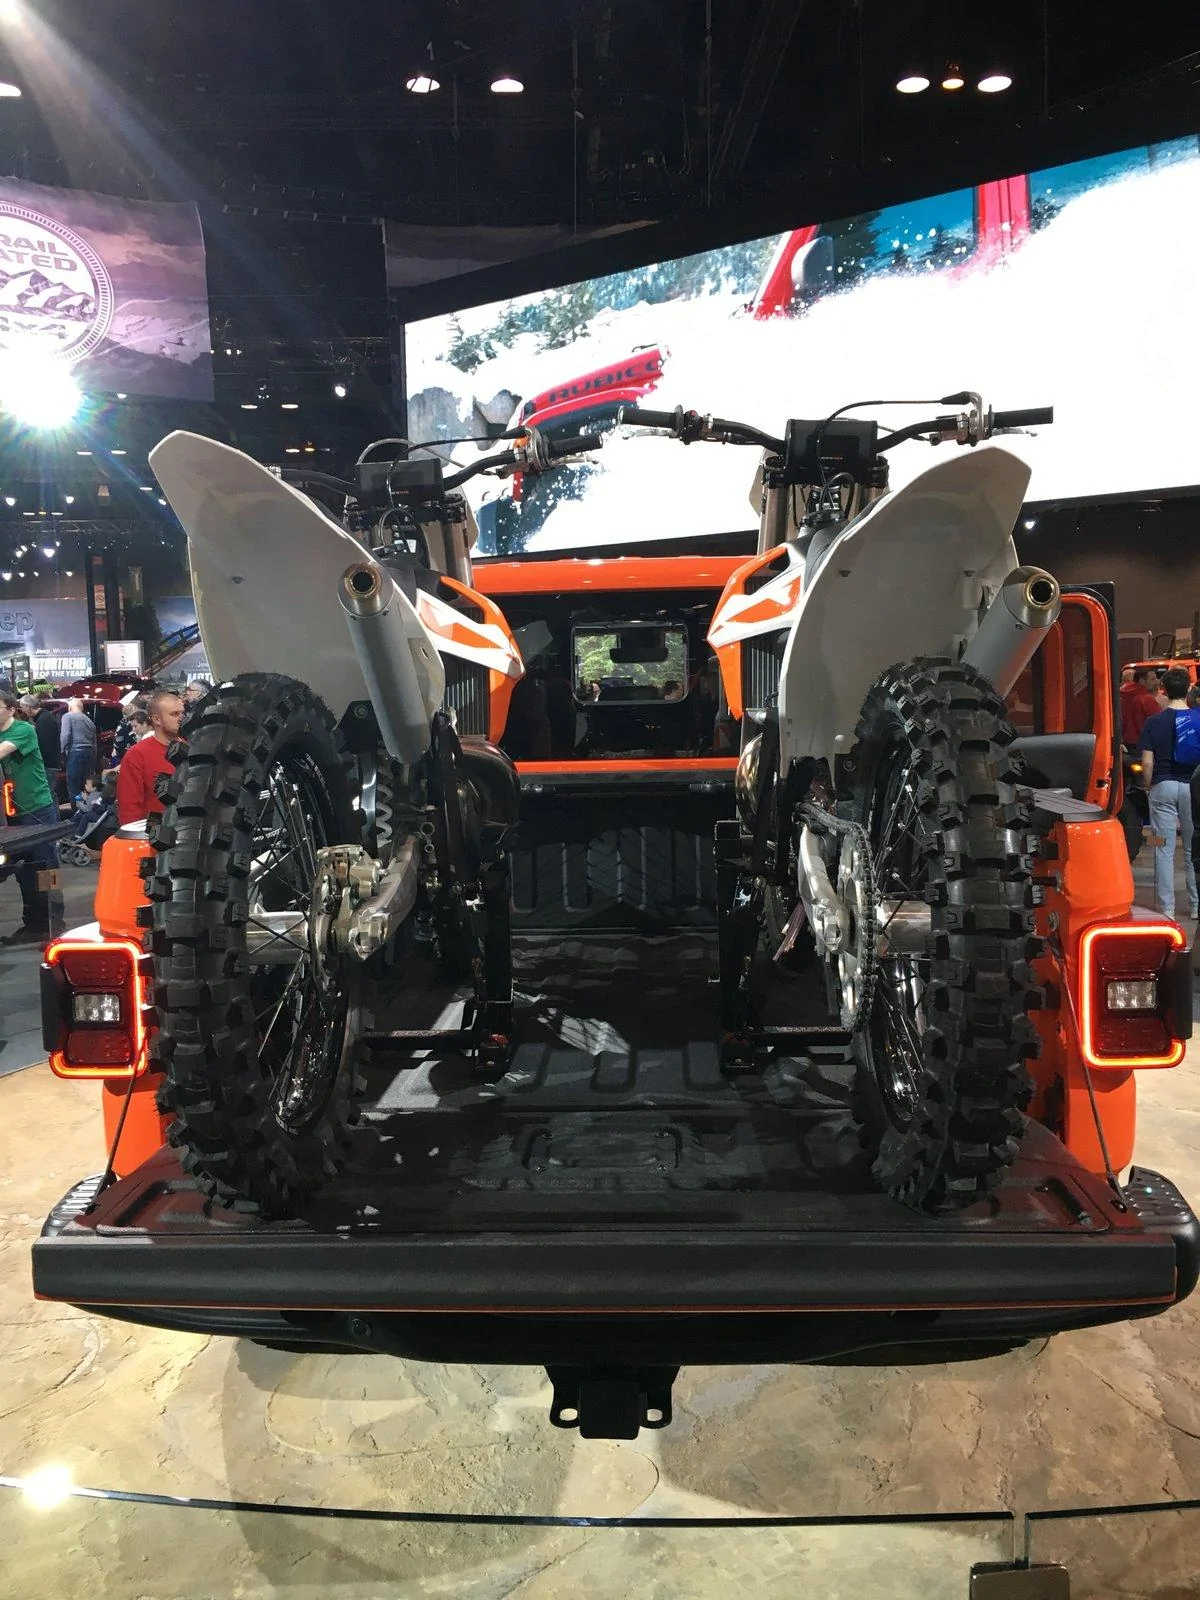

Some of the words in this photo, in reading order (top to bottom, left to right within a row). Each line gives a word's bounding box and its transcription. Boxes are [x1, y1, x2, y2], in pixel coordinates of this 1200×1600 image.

[0, 233, 69, 257] RAIL
[0, 248, 78, 272] ATED
[0, 611, 34, 635] ep
[30, 657, 87, 671] OTORTREND
